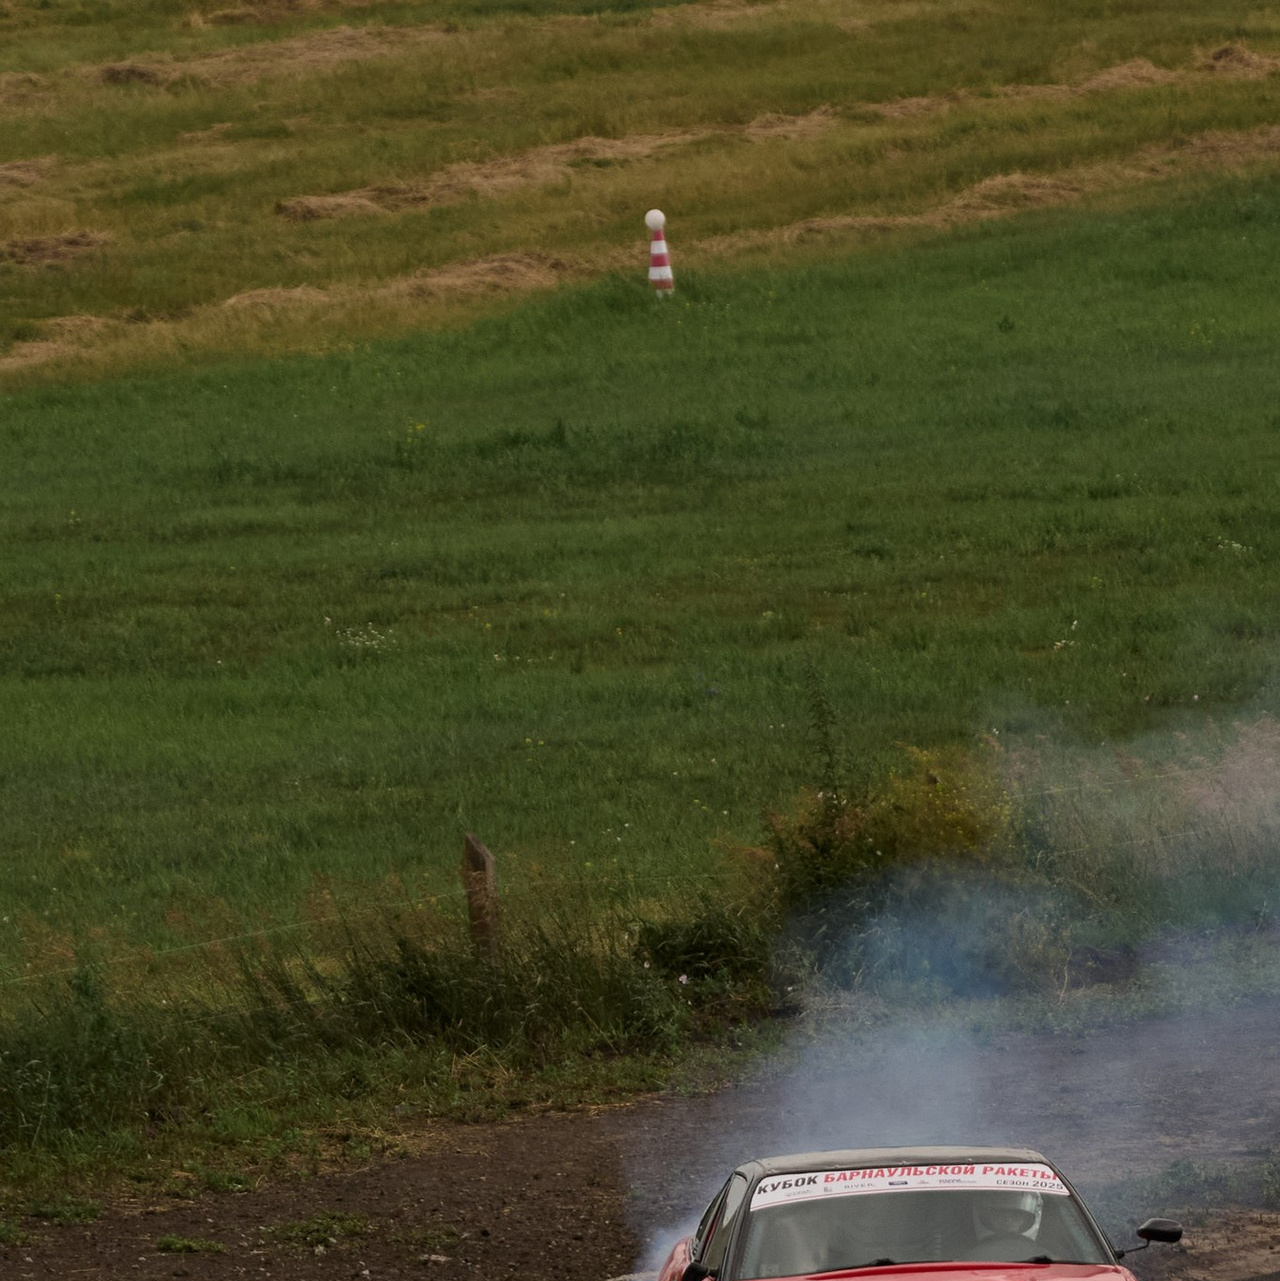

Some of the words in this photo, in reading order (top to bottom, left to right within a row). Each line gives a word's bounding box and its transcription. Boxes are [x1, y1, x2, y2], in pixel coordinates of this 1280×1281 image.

[757, 1175, 818, 1195] КУБОК
[824, 1164, 975, 1183] БАРНАУЛЬСКОЙ
[1032, 1180, 1064, 1190] 2025
